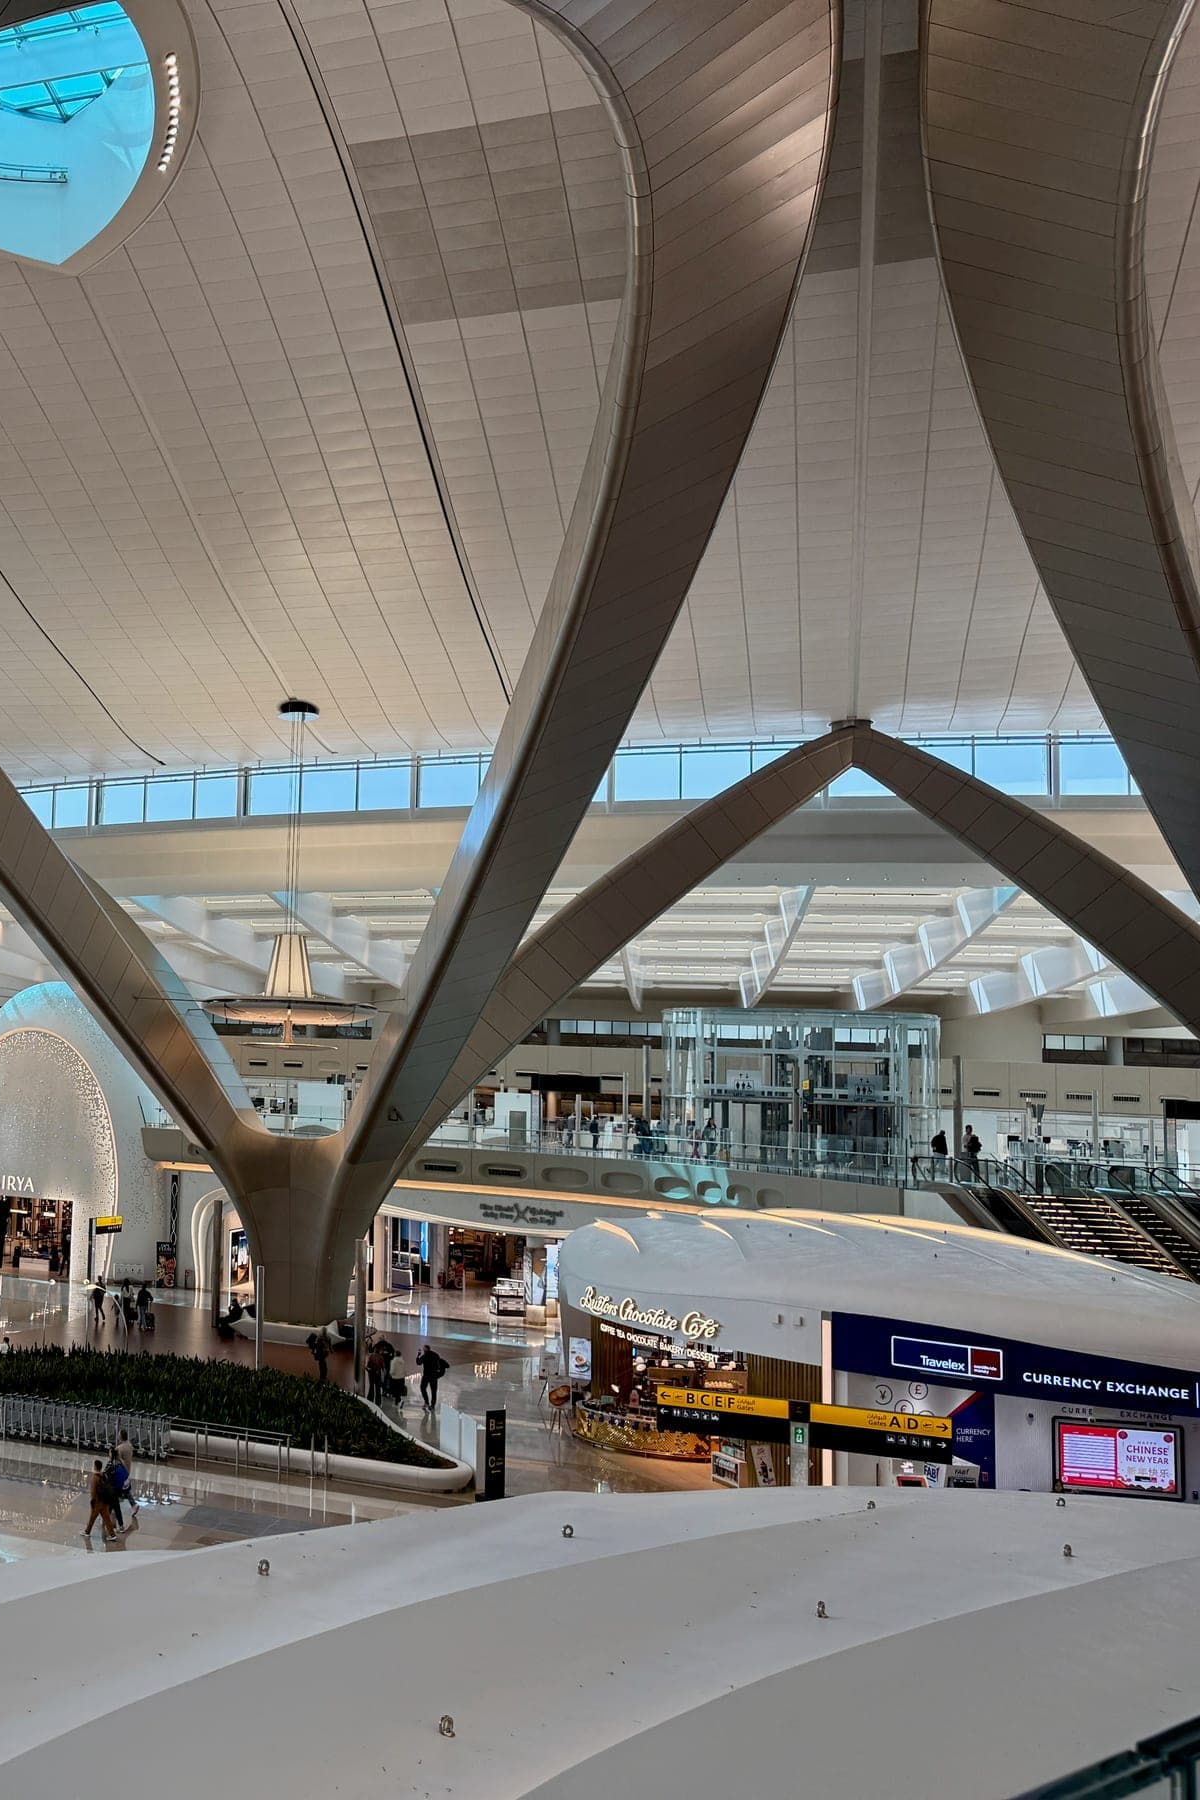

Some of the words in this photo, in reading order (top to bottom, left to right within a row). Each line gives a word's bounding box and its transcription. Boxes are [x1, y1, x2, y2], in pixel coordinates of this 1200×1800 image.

[580, 1285, 618, 1316] Butlers
[620, 1298, 678, 1330] Chocolate
[681, 1311, 719, 1340] Café
[600, 1323, 616, 1336] COFFEE
[616, 1328, 626, 1340] TEA
[626, 1333, 658, 1349] CHOCOLATE
[659, 1341, 685, 1356] BAKERY
[686, 1348, 719, 1363] DESSERT
[920, 1354, 966, 1371] Travelex
[1023, 1372, 1102, 1390] CURRENCY
[1106, 1381, 1190, 1399] EXCHANGE
[686, 1393, 695, 1404] B
[700, 1394, 710, 1406] C
[715, 1396, 723, 1408] E
[728, 1397, 736, 1409] F
[489, 1419, 496, 1431] B
[868, 1419, 887, 1427] Gates
[889, 1416, 901, 1429] A
[907, 1417, 919, 1430] D
[956, 1427, 992, 1436] CURRENCY
[956, 1435, 974, 1443] HERE
[1126, 1444, 1169, 1456] CHINESE
[488, 1456, 496, 1468] C
[1125, 1455, 1146, 1463] NEW
[1147, 1456, 1169, 1465] YEAR
